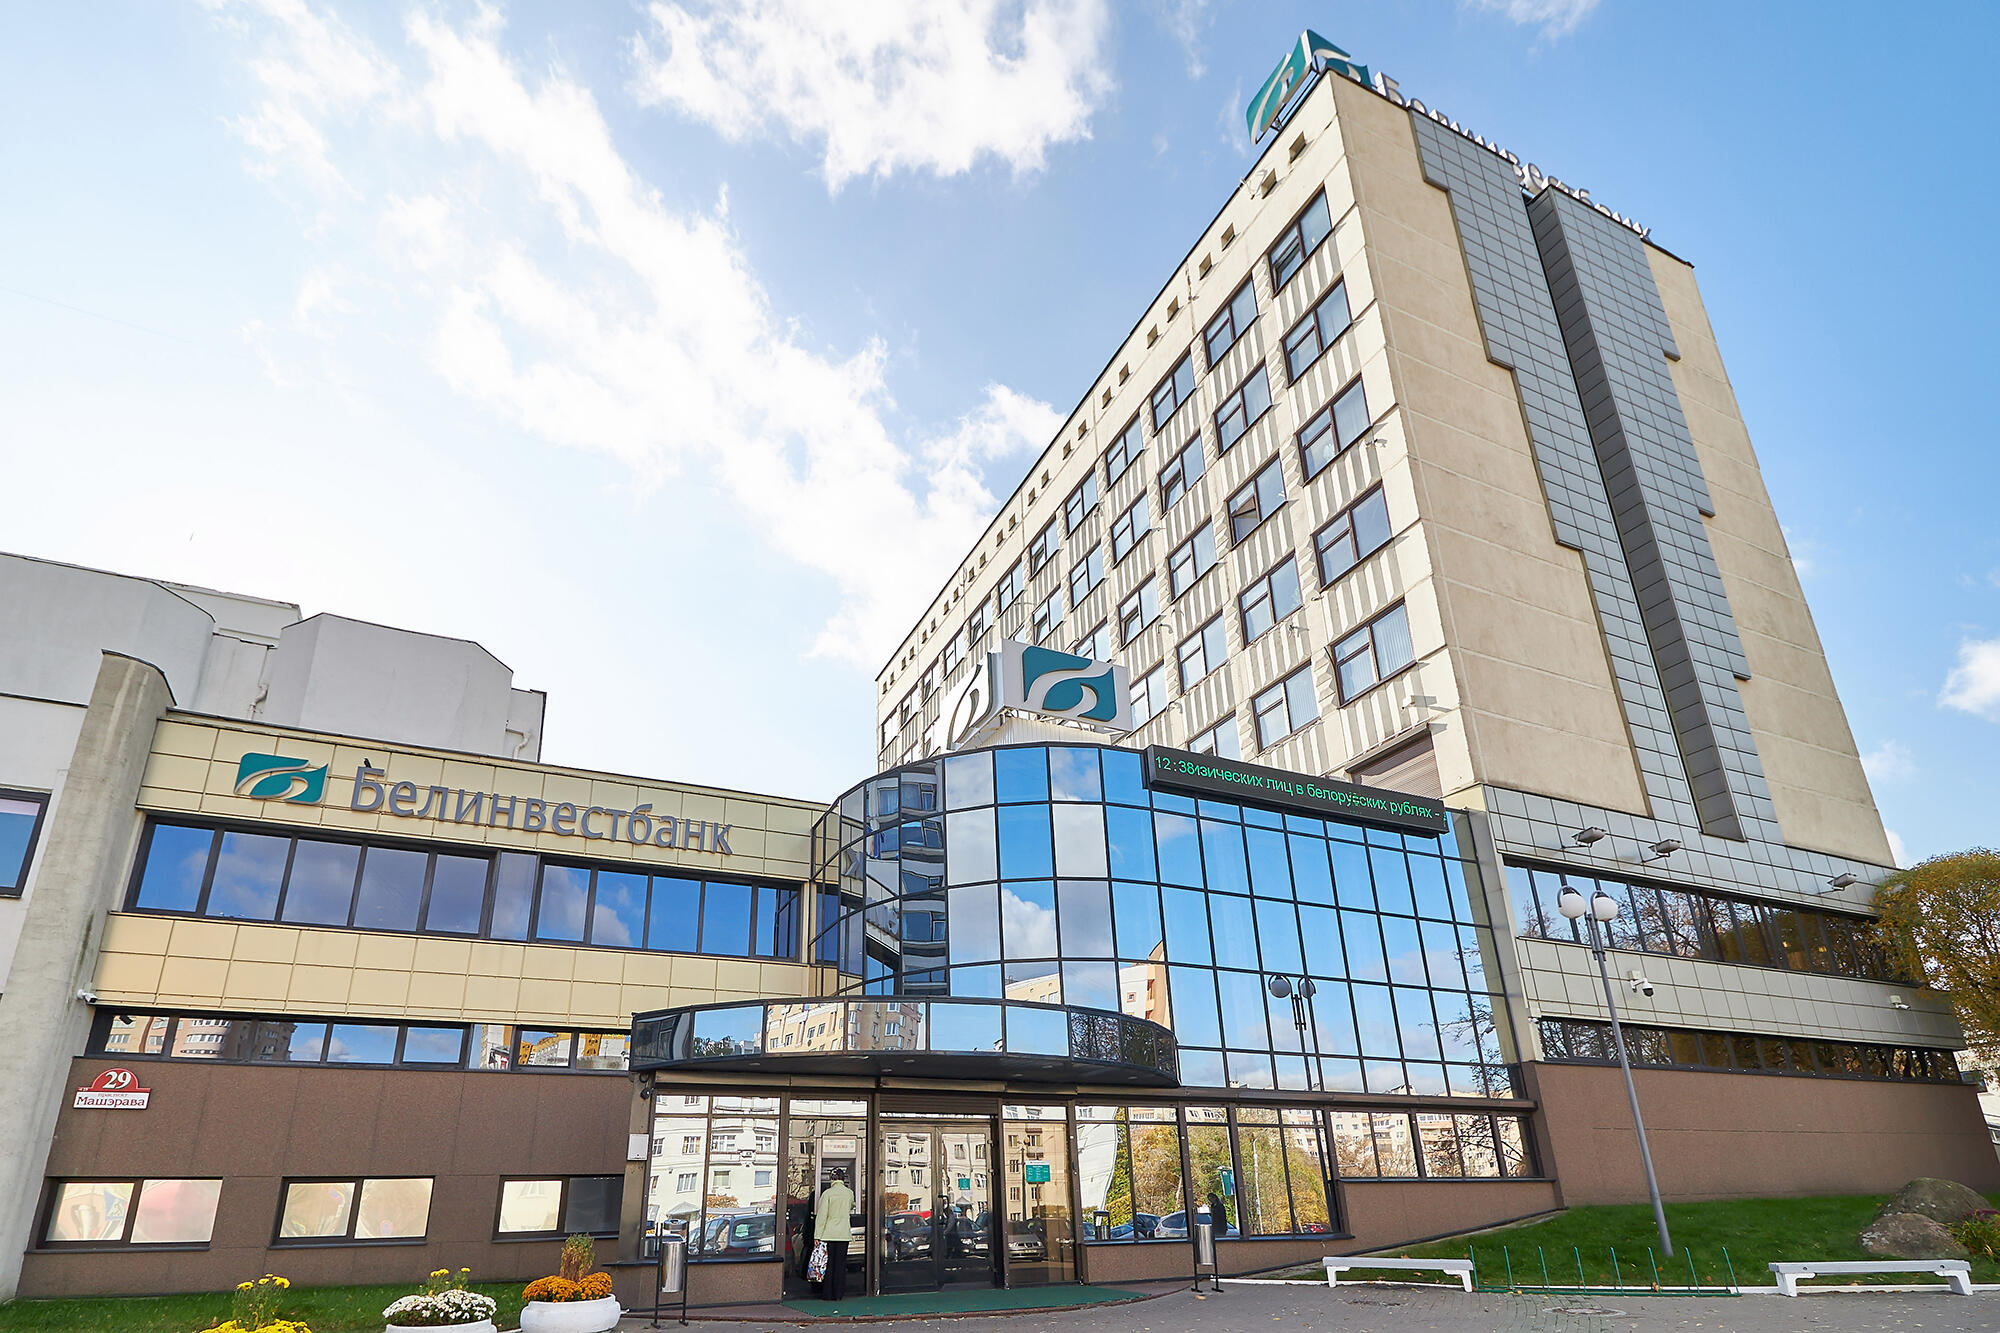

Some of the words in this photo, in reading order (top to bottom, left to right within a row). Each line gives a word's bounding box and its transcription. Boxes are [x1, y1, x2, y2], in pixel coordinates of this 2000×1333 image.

[350, 766, 734, 856] Белинвестбанк
[1266, 778, 1294, 797] лиц
[1295, 783, 1304, 795] в
[1389, 801, 1433, 819] рублях
[102, 1071, 132, 1090] 29
[76, 1096, 145, 1107] Машэрава
